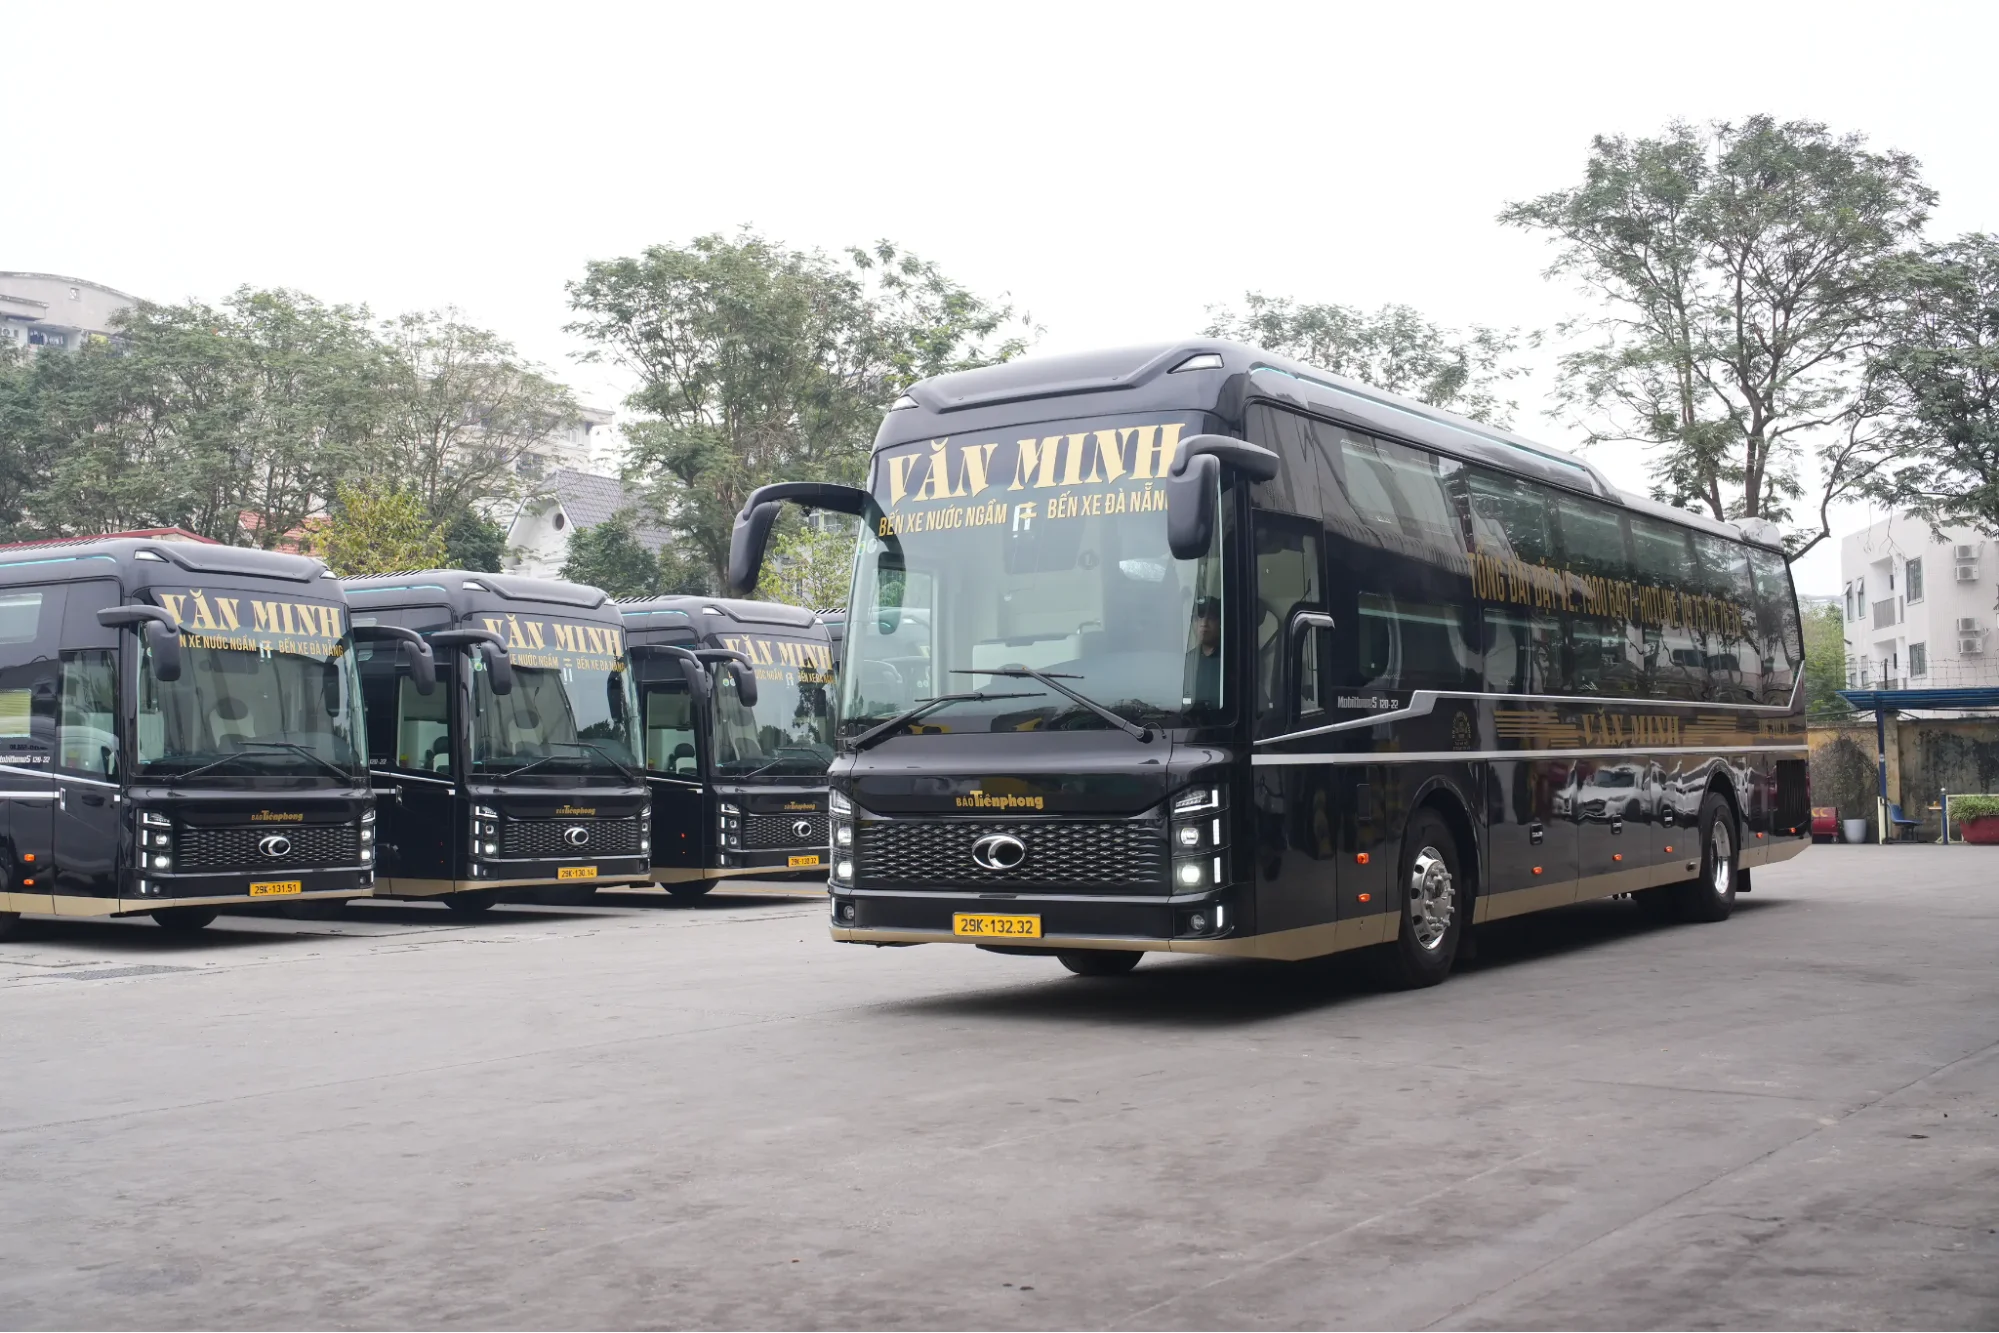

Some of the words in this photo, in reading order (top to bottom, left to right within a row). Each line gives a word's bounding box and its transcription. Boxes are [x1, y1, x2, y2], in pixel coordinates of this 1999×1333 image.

[888, 437, 999, 507] VĂN
[1007, 423, 1186, 492] MINH
[879, 508, 904, 537] BẾN
[905, 512, 924, 533] XE
[926, 504, 963, 531] NƯỚC
[965, 498, 1008, 527] NGẦM
[1047, 490, 1078, 519] BẾN
[1081, 494, 1102, 516] XE
[1105, 488, 1125, 514] ĐÀ
[1129, 481, 1168, 513] NẴN
[159, 589, 241, 632] VĂN
[250, 600, 343, 639] MINH
[188, 635, 201, 649] XE
[202, 633, 229, 650] NƯỚC
[278, 636, 296, 654] BẾN
[297, 640, 309, 655] XE
[552, 623, 624, 657] MINH
[777, 641, 833, 670] MINH
[1581, 706, 1624, 746] VĂN
[1630, 714, 1679, 745] MINH
[960, 918, 1033, 934] 29K-132.32
